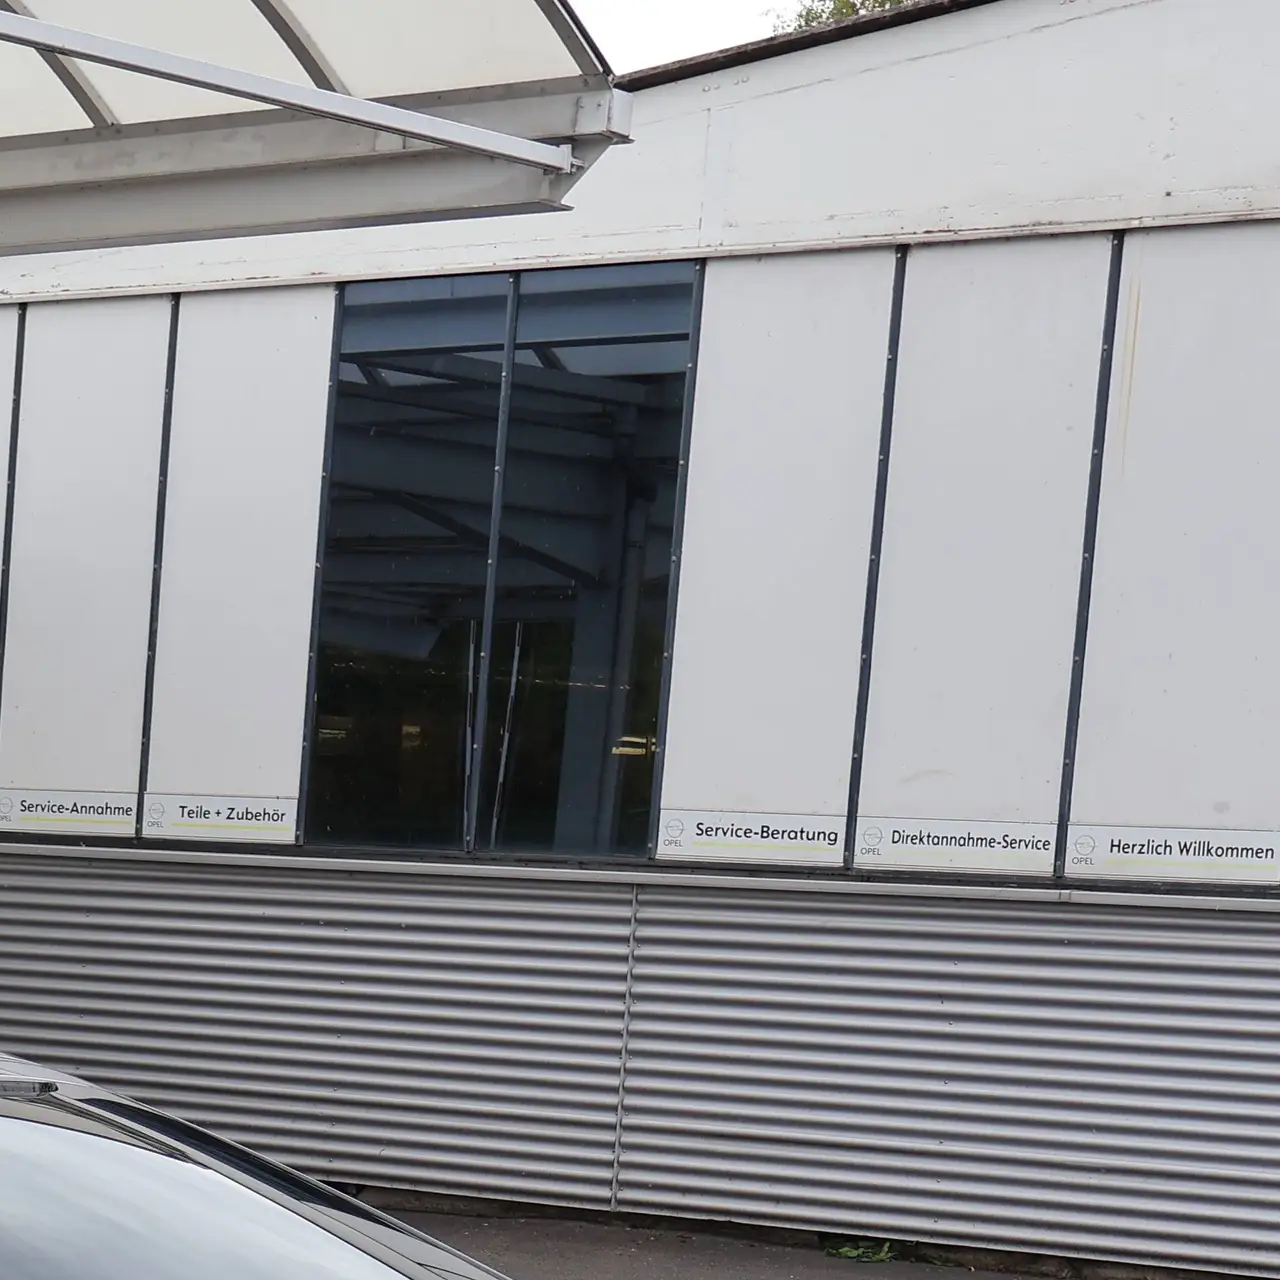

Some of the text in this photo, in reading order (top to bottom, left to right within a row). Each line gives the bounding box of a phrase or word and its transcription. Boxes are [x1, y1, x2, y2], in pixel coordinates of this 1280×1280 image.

[19, 799, 133, 817] Service-Annahme
[179, 805, 211, 820] Teile
[226, 806, 287, 823] Zubehör
[147, 820, 165, 829] OPEL
[663, 838, 684, 848] OPEL
[695, 822, 839, 846] Service-Beratung
[891, 829, 1051, 851] Direktannahme-Service
[860, 847, 882, 856] OPEL
[1109, 838, 1276, 860] Herzlich Willkommen
[1071, 856, 1095, 866] OPEL
